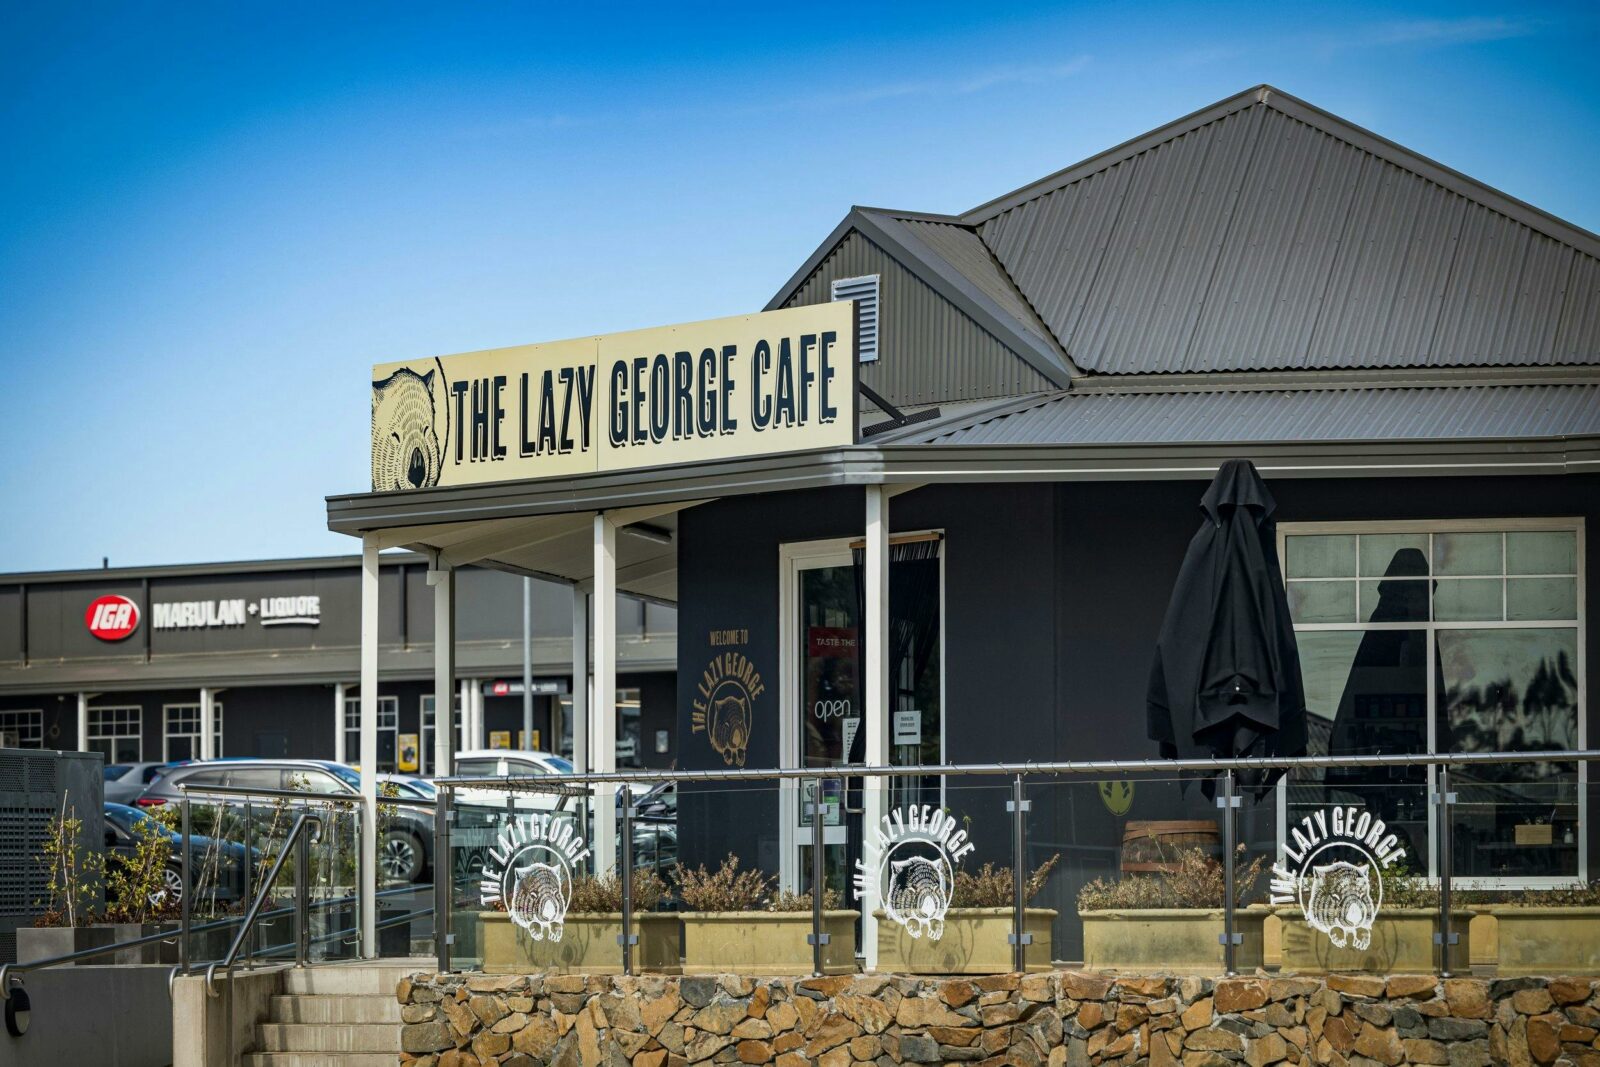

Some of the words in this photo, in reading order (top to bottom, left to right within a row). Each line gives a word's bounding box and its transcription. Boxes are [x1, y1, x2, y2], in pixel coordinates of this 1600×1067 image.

[451, 375, 507, 466] THE
[519, 364, 596, 458] LAZY
[609, 345, 738, 449] GEORGE
[750, 331, 838, 432] CAFE
[90, 604, 130, 630] IGA
[153, 599, 246, 628] MARULAN
[260, 596, 320, 618] LIQUOR
[710, 630, 740, 646] WELCOME
[740, 629, 749, 644] TO
[816, 638, 839, 646] TASTE
[840, 638, 856, 647] THE
[698, 656, 724, 699] LAZY
[724, 652, 765, 701] GEORGE
[691, 698, 707, 735] THE
[814, 700, 851, 723] open
[489, 816, 527, 866] LAZY
[529, 813, 591, 868] GEORGE
[863, 807, 905, 858] LAZY
[908, 804, 976, 863] GEORGE
[1281, 809, 1329, 864] LAZY
[1332, 806, 1407, 869] GEORGE
[480, 865, 502, 906] THE
[853, 858, 878, 901] THE
[1269, 862, 1298, 906] THE
